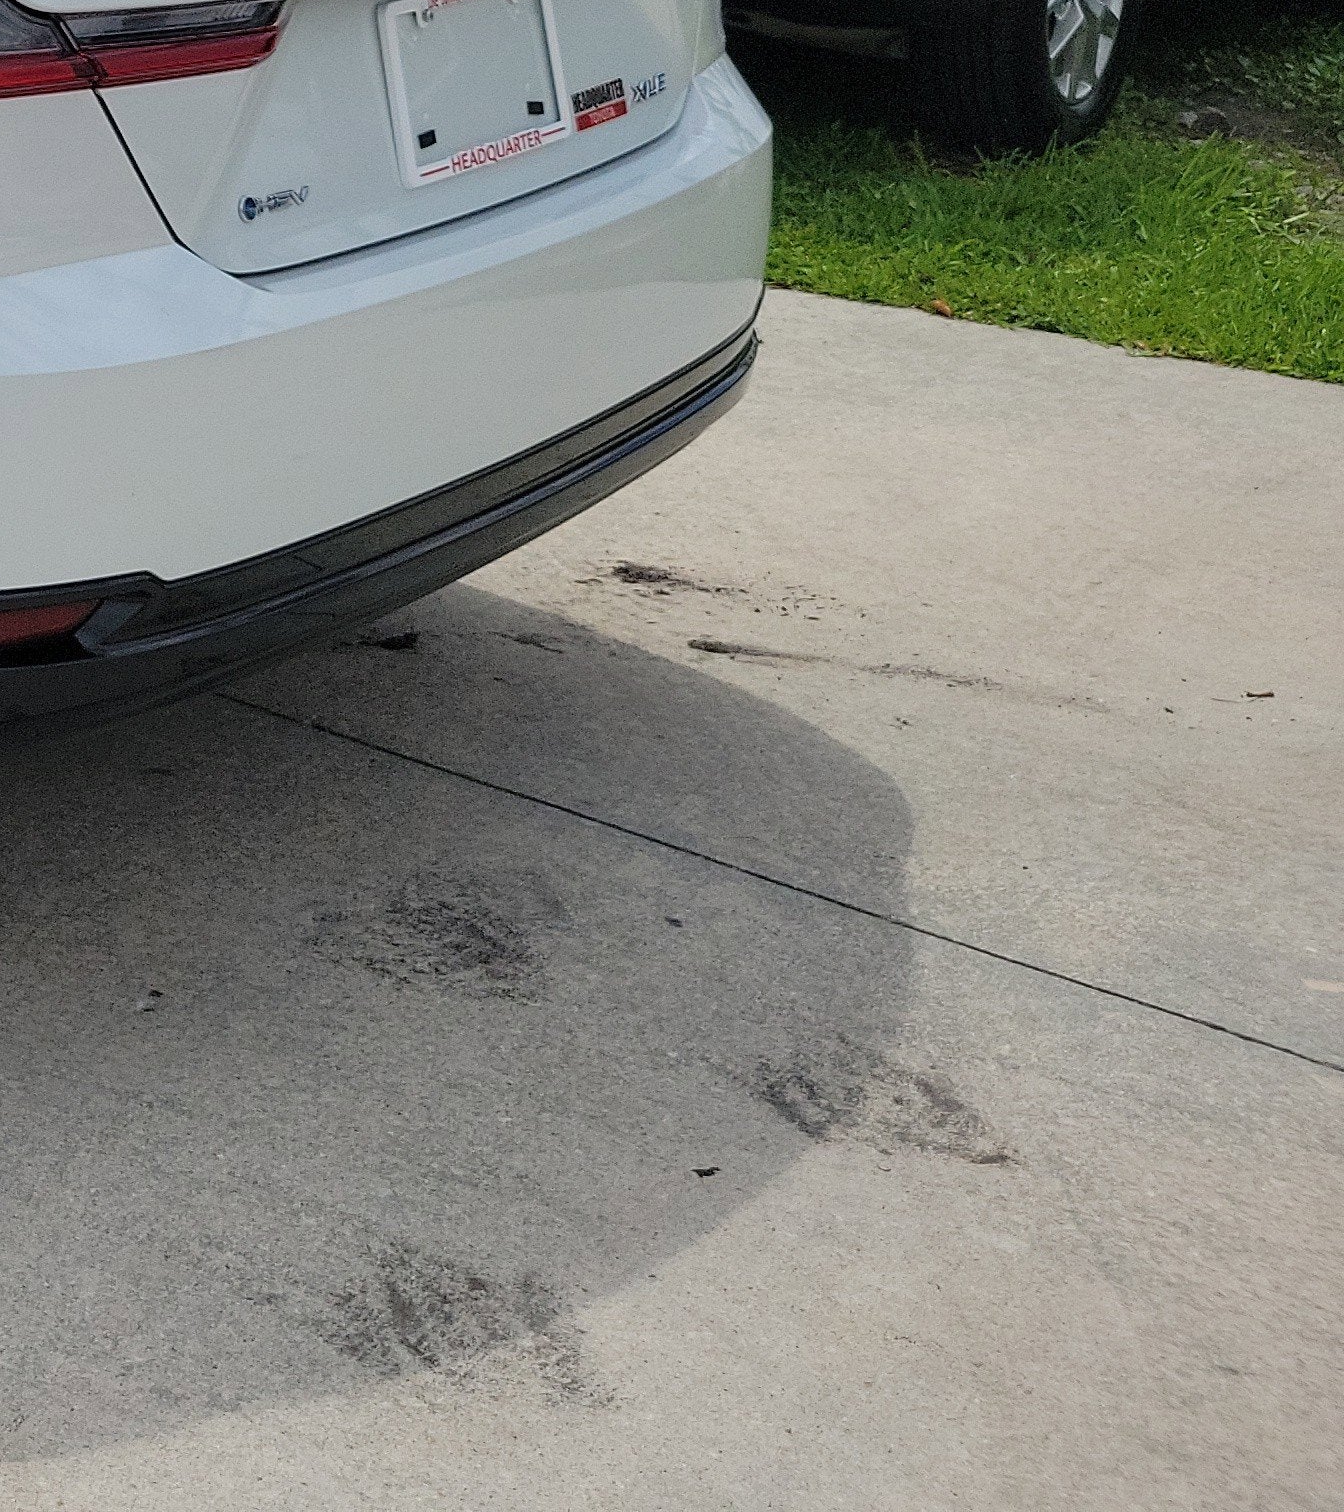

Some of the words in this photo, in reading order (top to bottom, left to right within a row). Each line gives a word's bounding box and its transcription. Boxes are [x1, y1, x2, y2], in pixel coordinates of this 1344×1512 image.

[571, 78, 624, 113] HEADQUARTER
[632, 72, 666, 103] XLE
[450, 130, 542, 173] HEADQUARTER
[254, 185, 309, 215] HEV
